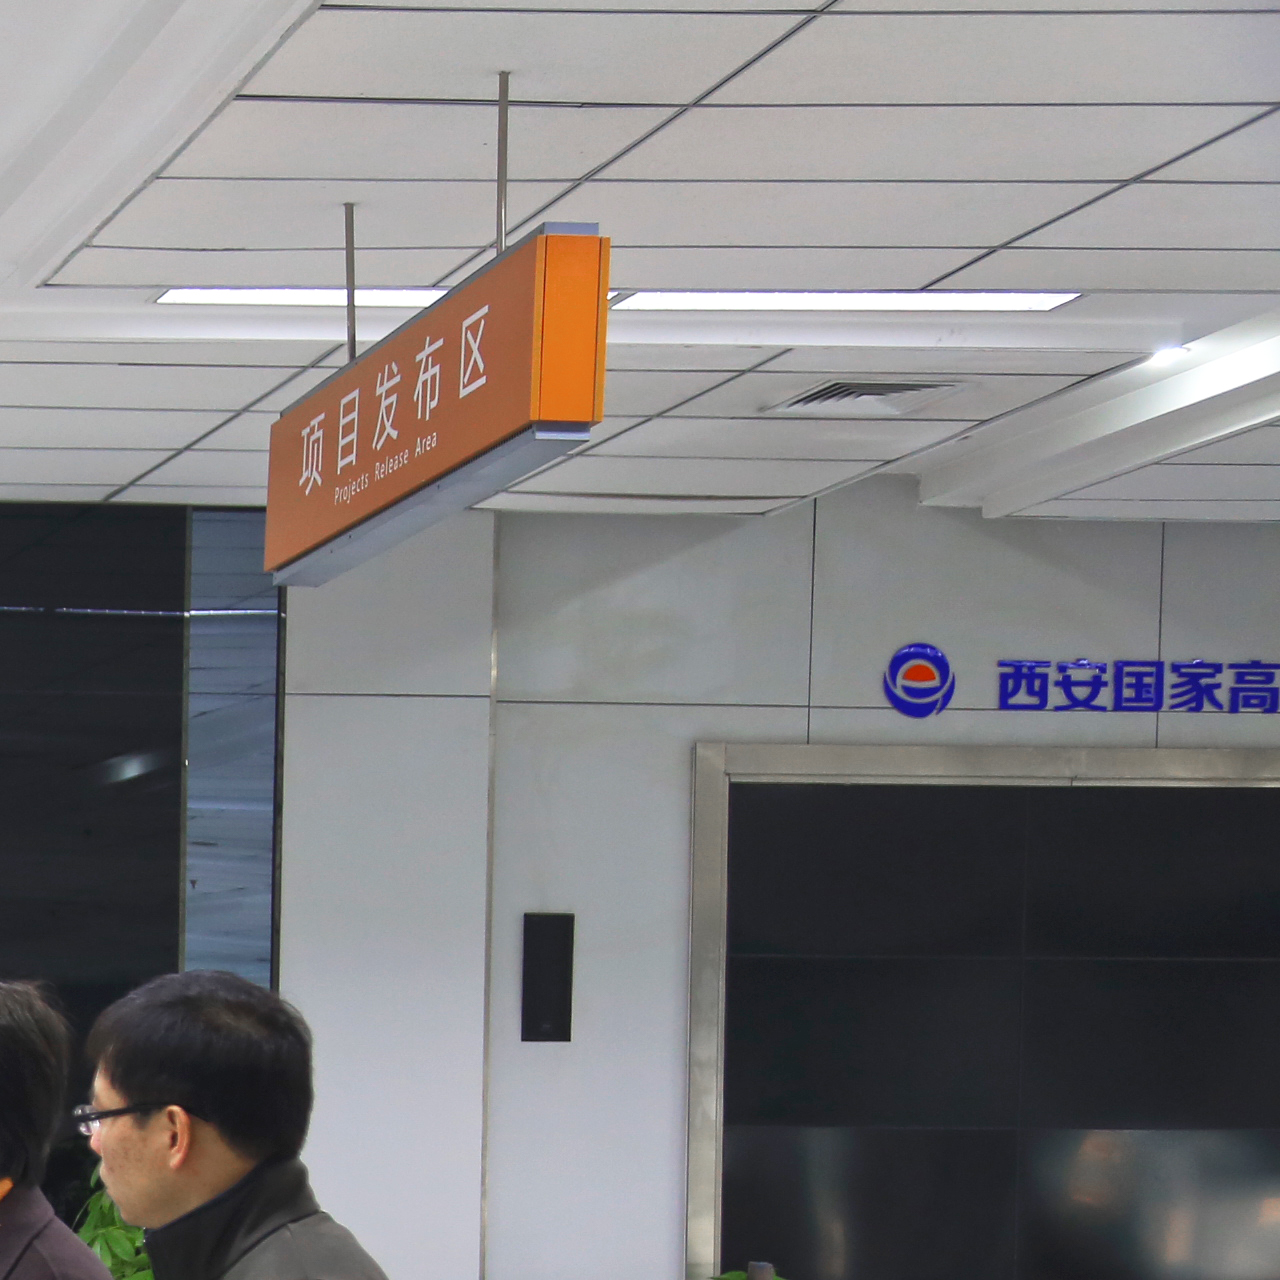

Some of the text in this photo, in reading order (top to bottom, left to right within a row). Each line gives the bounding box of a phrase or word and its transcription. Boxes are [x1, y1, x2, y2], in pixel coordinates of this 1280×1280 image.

[298, 304, 490, 496] 项目发布区
[334, 432, 437, 506] Projects Release Area
[997, 657, 1280, 714] 西安国家高
